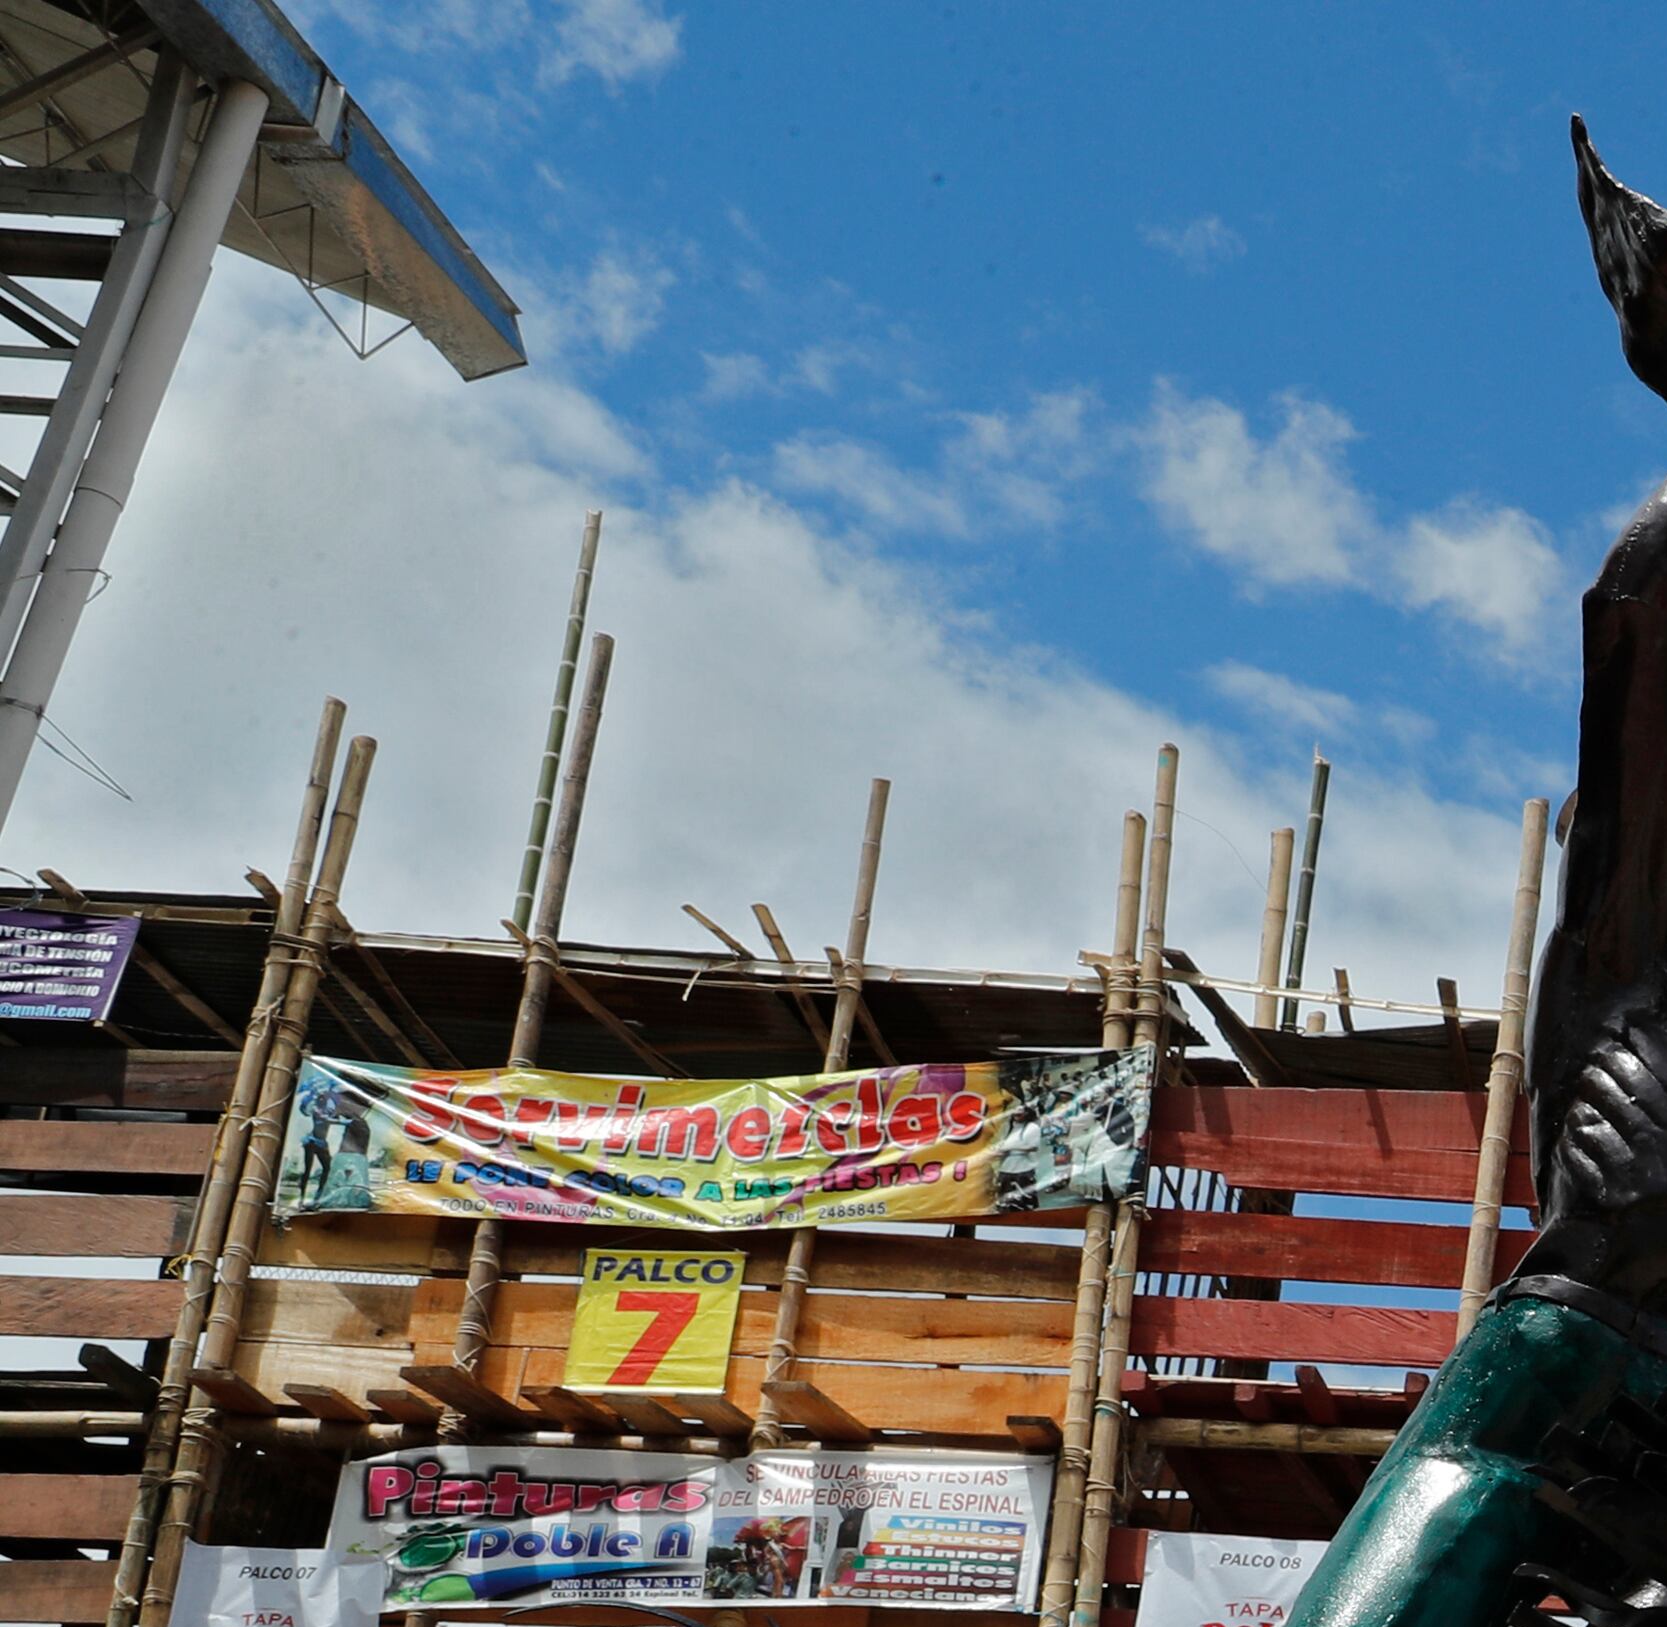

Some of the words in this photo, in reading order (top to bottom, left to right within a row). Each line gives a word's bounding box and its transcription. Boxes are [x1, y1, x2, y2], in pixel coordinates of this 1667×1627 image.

[24, 945, 46, 959] DE
[48, 947, 113, 963] TENSIÓN
[35, 982, 100, 997] DOMICILIO
[403, 1077, 987, 1162] Servimezclas
[405, 1160, 442, 1183] LE
[564, 1170, 685, 1197] COLOR
[696, 1182, 723, 1201] A
[735, 1177, 793, 1200] LAS
[805, 1162, 942, 1194] FIESTAS
[439, 1198, 487, 1213] TODO
[495, 1201, 517, 1214] EN
[525, 1202, 614, 1219] PINTURAS
[818, 1203, 886, 1219] 2485845
[592, 1256, 735, 1284] PALCO
[606, 1291, 701, 1386] 7
[772, 1463, 858, 1482] VINCULA
[926, 1468, 1008, 1487] FIESTAS
[367, 1463, 711, 1516] Pinturas
[719, 1490, 752, 1508] DEL
[759, 1488, 873, 1509] SAMPEDRO
[876, 1490, 901, 1508] EN
[909, 1491, 932, 1509] EL
[939, 1492, 1025, 1515] ESPINAL
[900, 1517, 1022, 1535] Vinilos
[466, 1523, 643, 1559] Doble
[654, 1523, 695, 1559] A
[891, 1530, 1019, 1548] Estucos
[880, 1544, 1017, 1562] Thinner
[1219, 1552, 1275, 1568] PALCO
[1279, 1556, 1302, 1569] 08
[239, 1566, 293, 1580] PALCO
[296, 1567, 318, 1580] 07
[864, 1558, 1016, 1575] Barnicos
[582, 1579, 592, 1589] DE
[595, 1579, 623, 1589] VENTA
[242, 1613, 294, 1627] TAPA
[1225, 1603, 1285, 1620] TAPA
